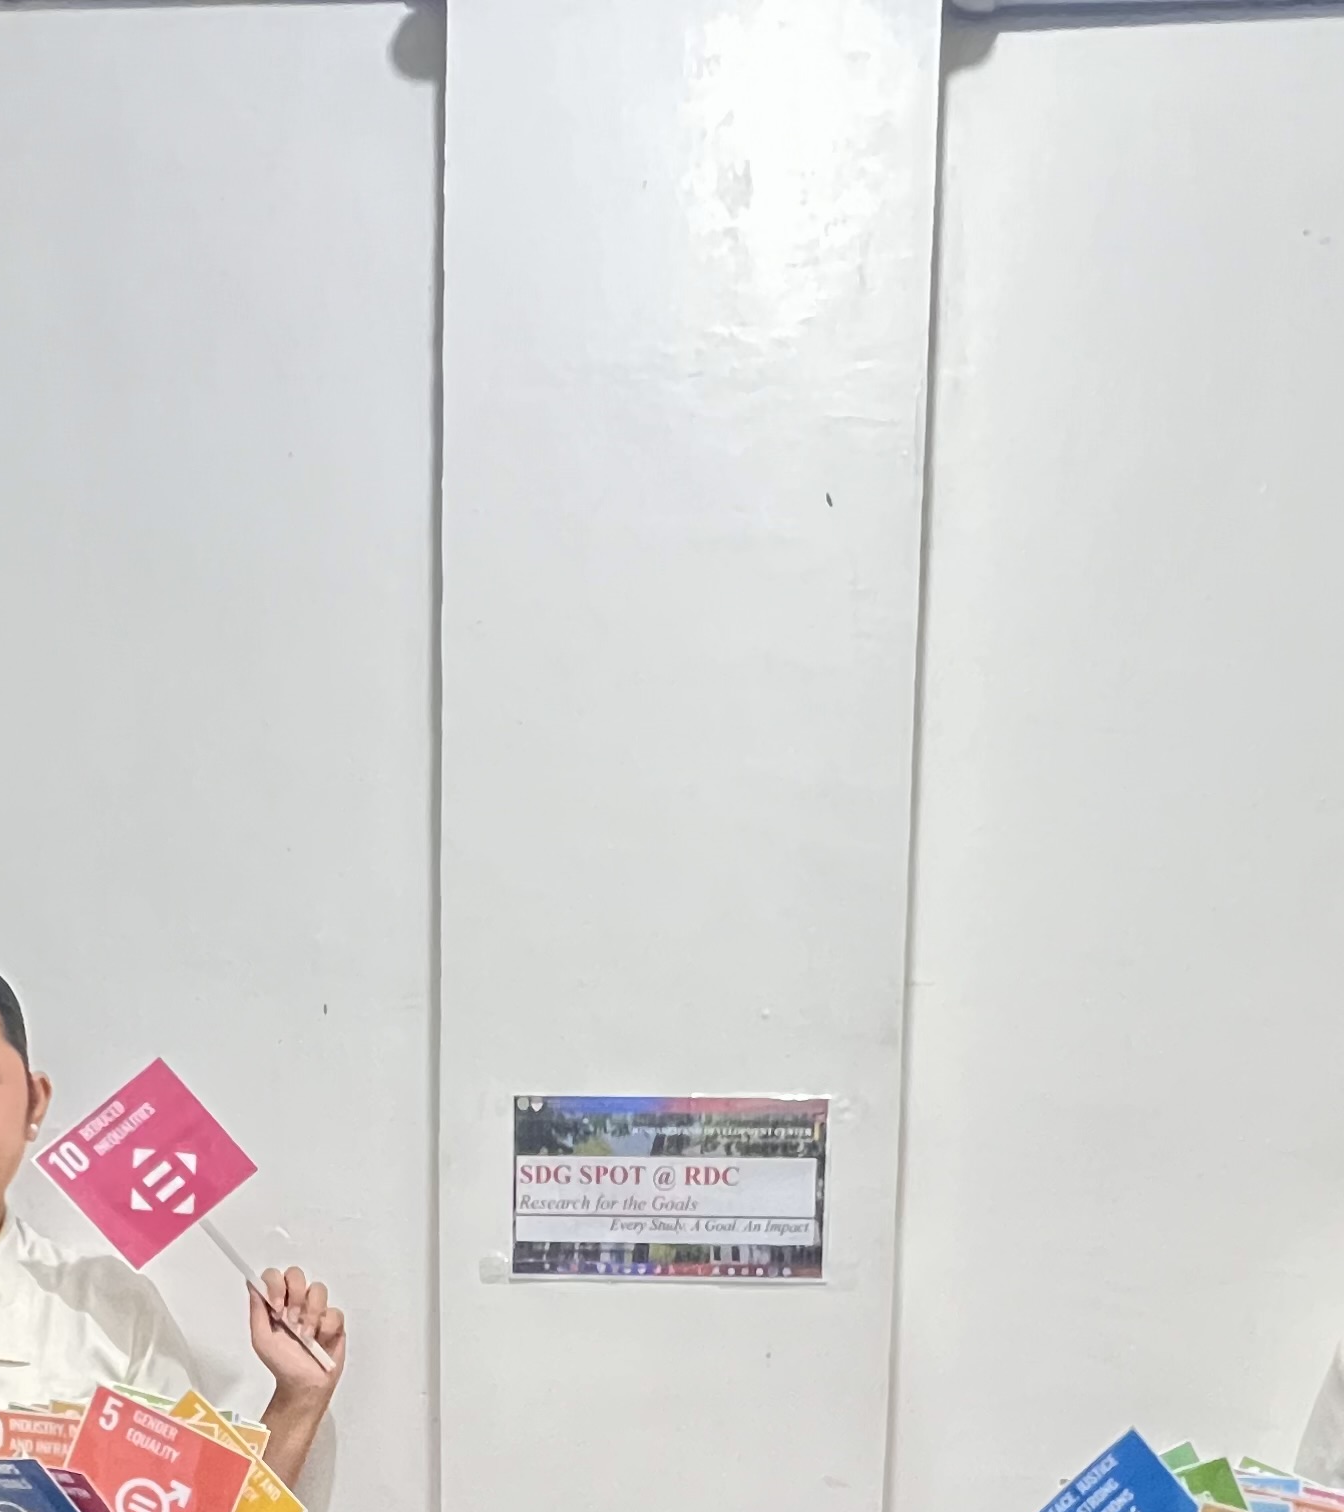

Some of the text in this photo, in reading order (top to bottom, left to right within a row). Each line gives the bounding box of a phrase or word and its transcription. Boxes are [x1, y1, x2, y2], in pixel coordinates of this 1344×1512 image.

[49, 1142, 90, 1180] 10
[520, 1165, 740, 1191] SDG SPOT @ RDC
[520, 1194, 698, 1214] Research for the Goals
[610, 1219, 646, 1236] Every
[690, 1220, 700, 1232] A
[742, 1221, 761, 1233] An
[764, 1222, 809, 1236] Impact
[98, 1397, 123, 1431] 5
[133, 1410, 179, 1442] GENDER
[126, 1427, 180, 1463] EQUALITY
